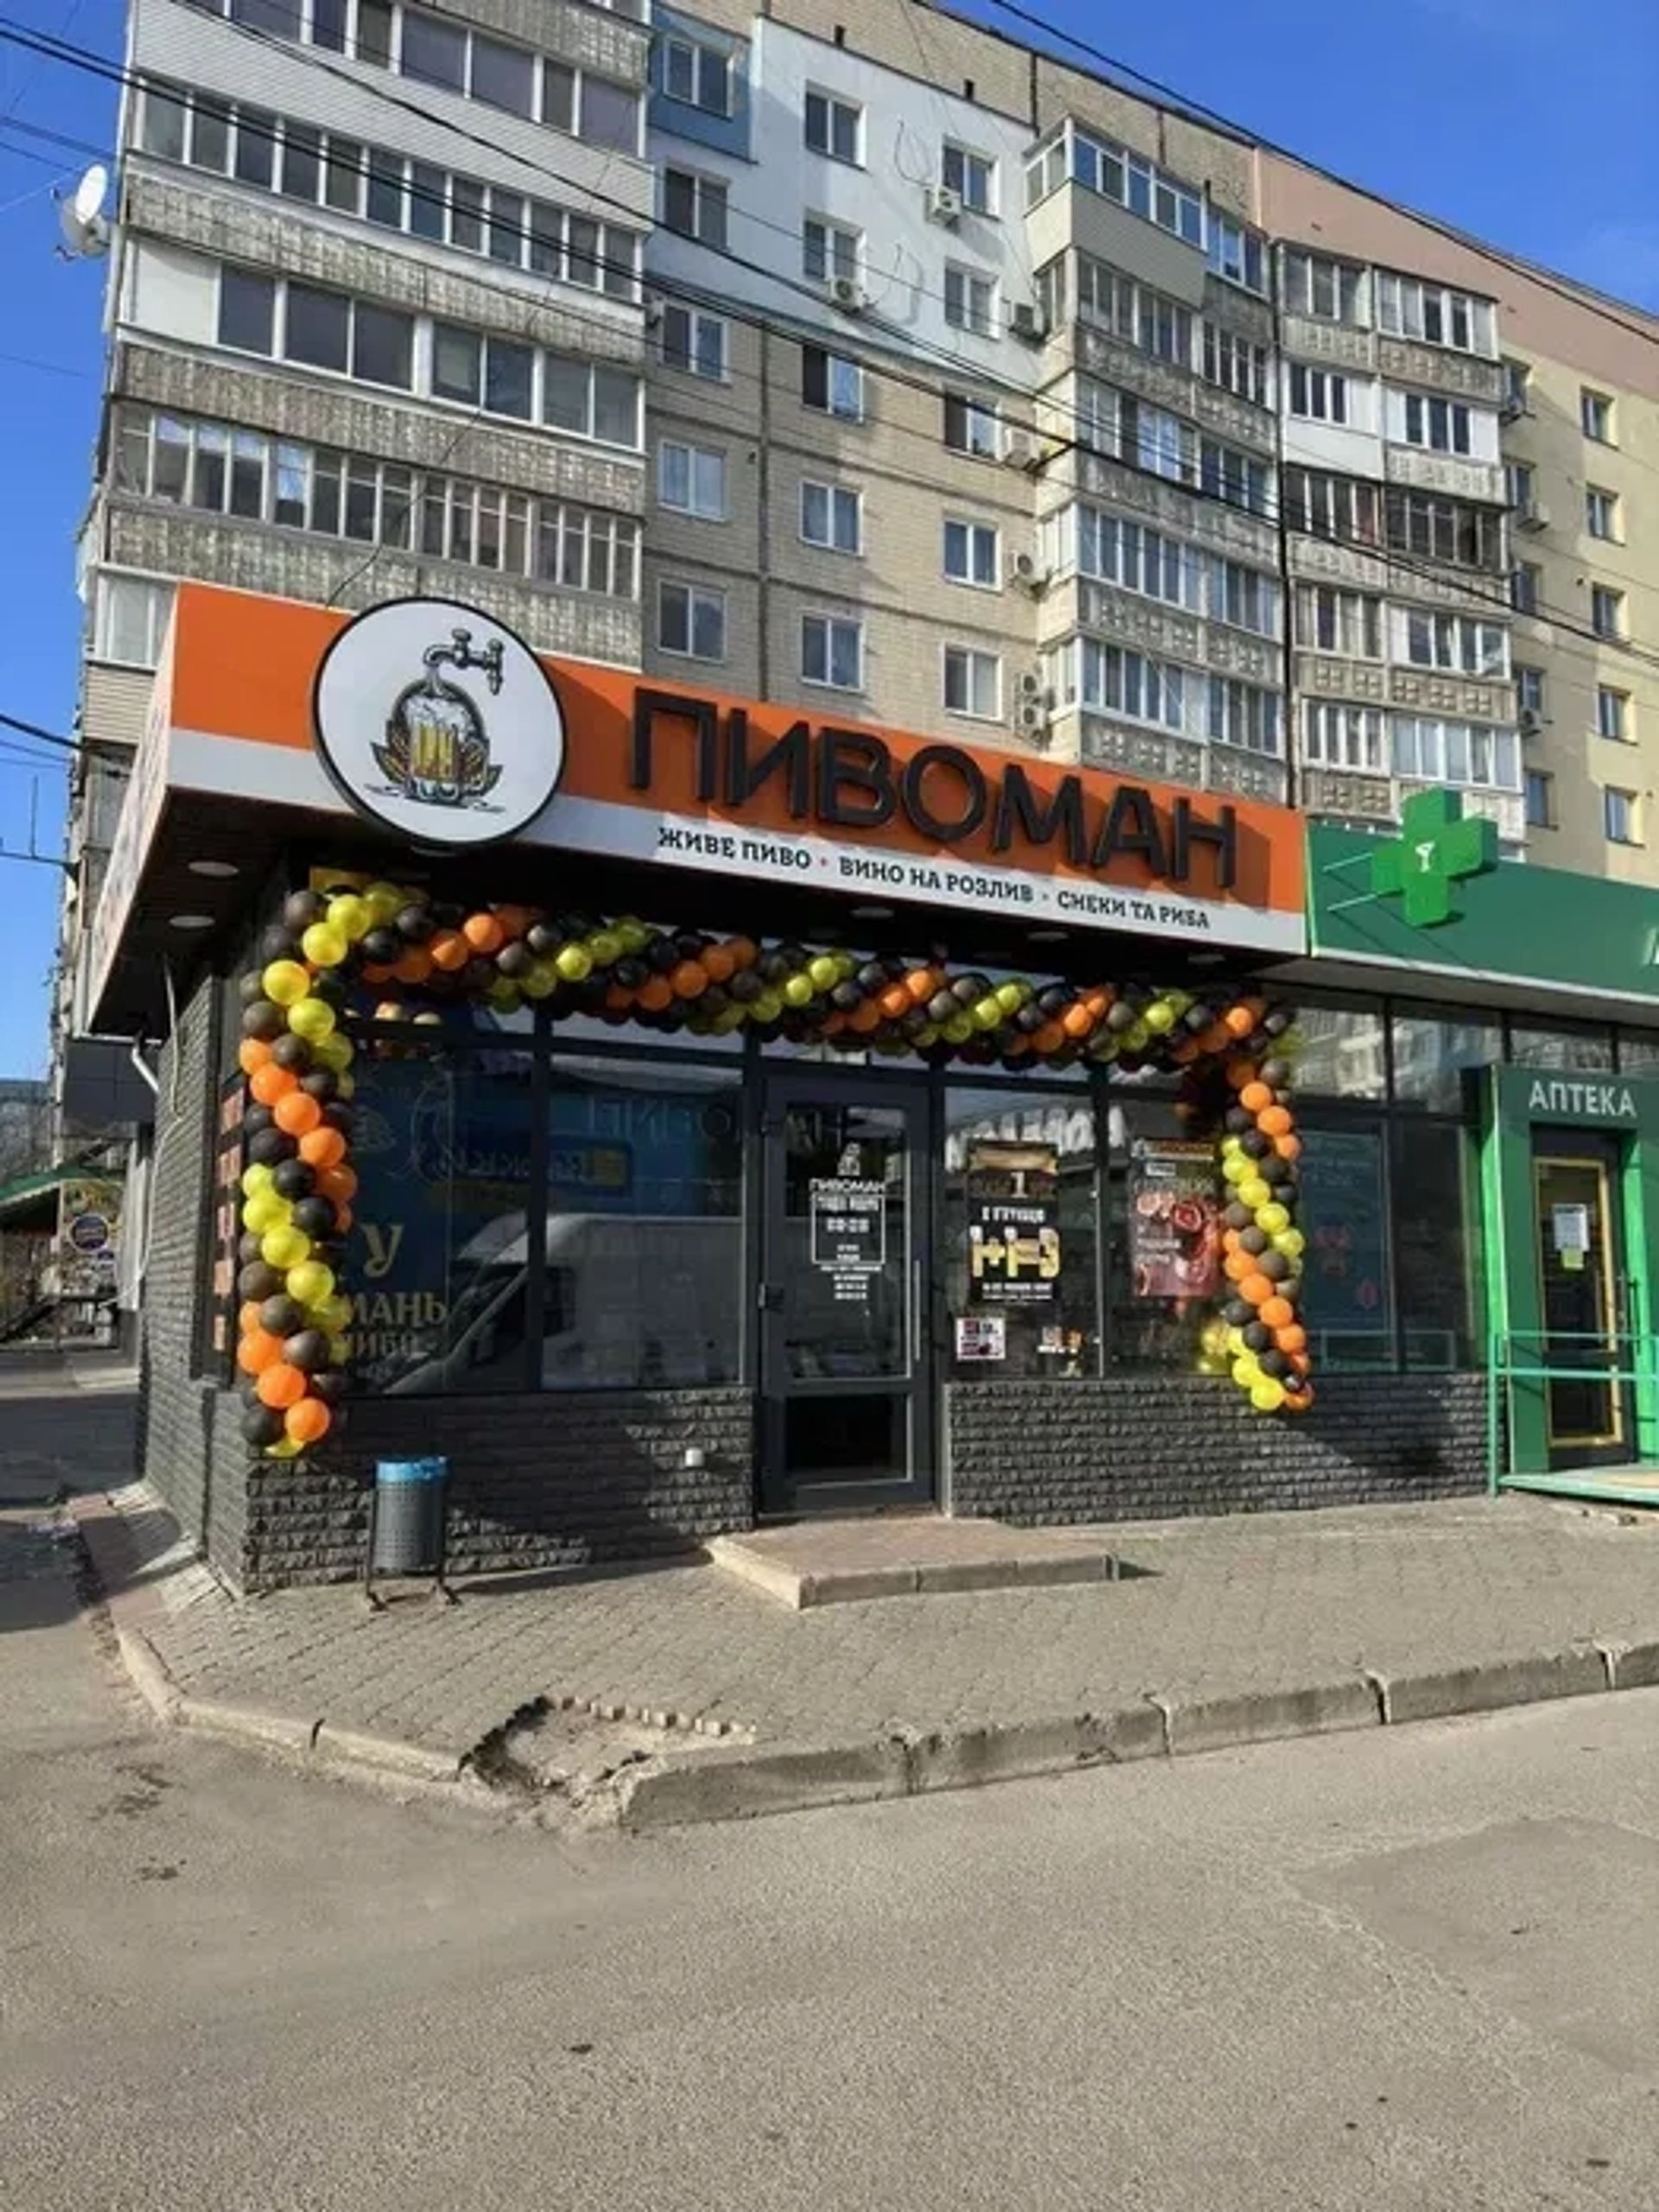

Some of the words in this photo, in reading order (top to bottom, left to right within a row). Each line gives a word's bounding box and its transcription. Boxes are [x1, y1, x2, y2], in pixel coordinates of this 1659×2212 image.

[632, 687, 1236, 888] ПИВОМАН
[658, 827, 735, 859] ЖИВЕ
[741, 841, 811, 870] ПИВО
[838, 856, 905, 883] ВИНО
[910, 868, 941, 890] НА
[946, 874, 1034, 902] РОЗЛИВ
[1057, 891, 1126, 918] СНЕКИ
[1129, 901, 1157, 922] ТА
[1160, 907, 1211, 929] РИБА
[1528, 1080, 1638, 1118] АПТЕКА
